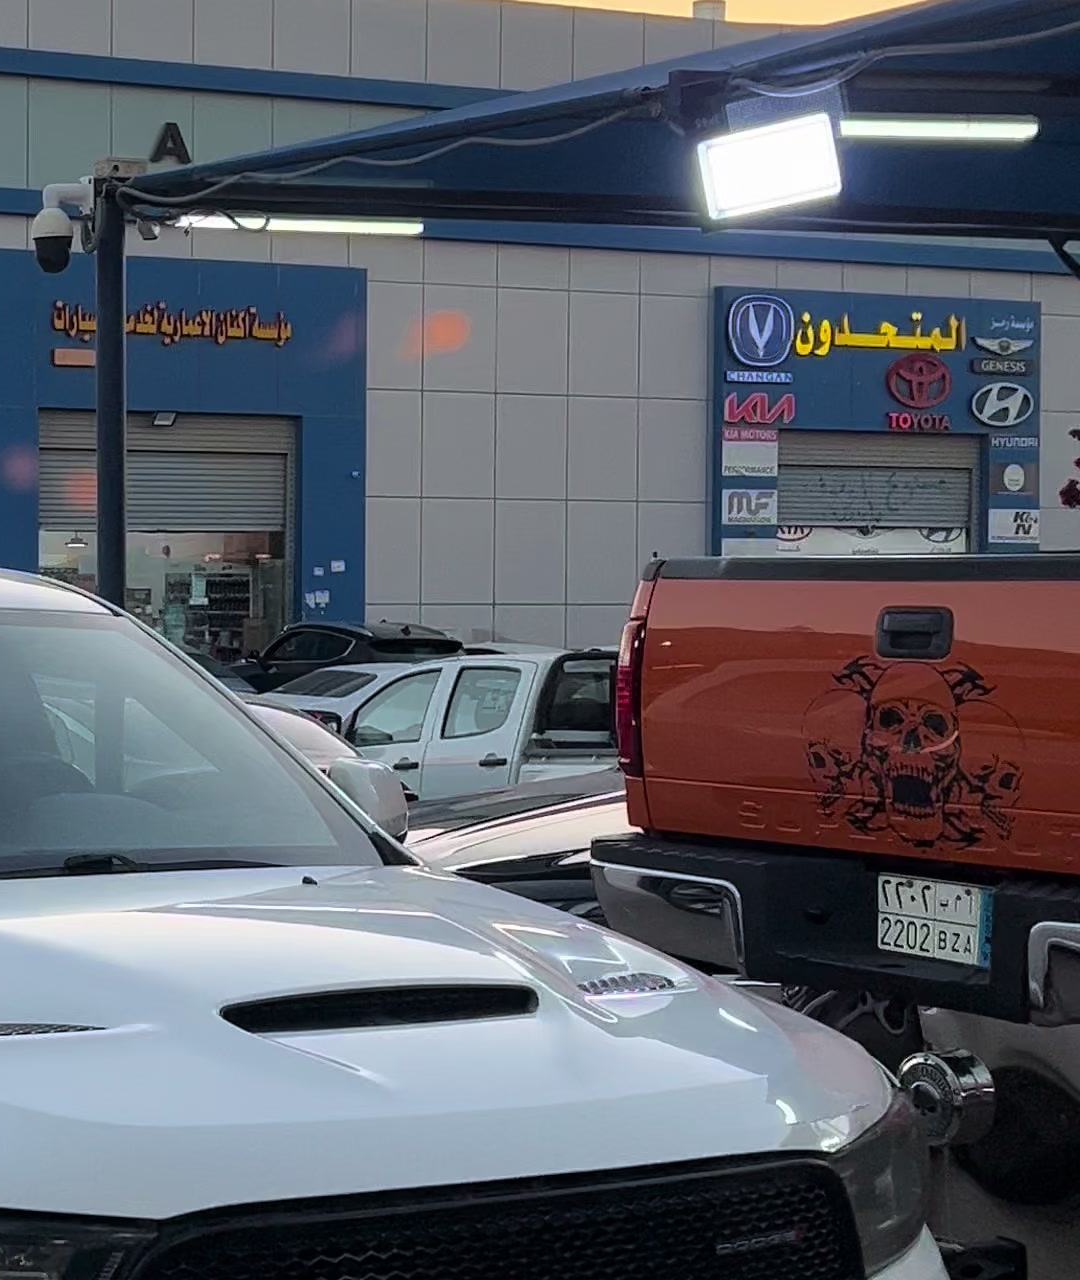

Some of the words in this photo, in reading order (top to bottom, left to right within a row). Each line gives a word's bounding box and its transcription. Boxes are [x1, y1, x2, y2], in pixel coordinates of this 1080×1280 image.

[150, 122, 191, 164] A
[981, 361, 1026, 373] GENESIS
[727, 371, 793, 382] CHANGAN
[888, 412, 952, 430] TOYOTA
[725, 430, 739, 439] KIA
[740, 430, 777, 440] MOTORS
[991, 437, 1039, 447] HYUNDAI
[880, 917, 931, 953] 2202
